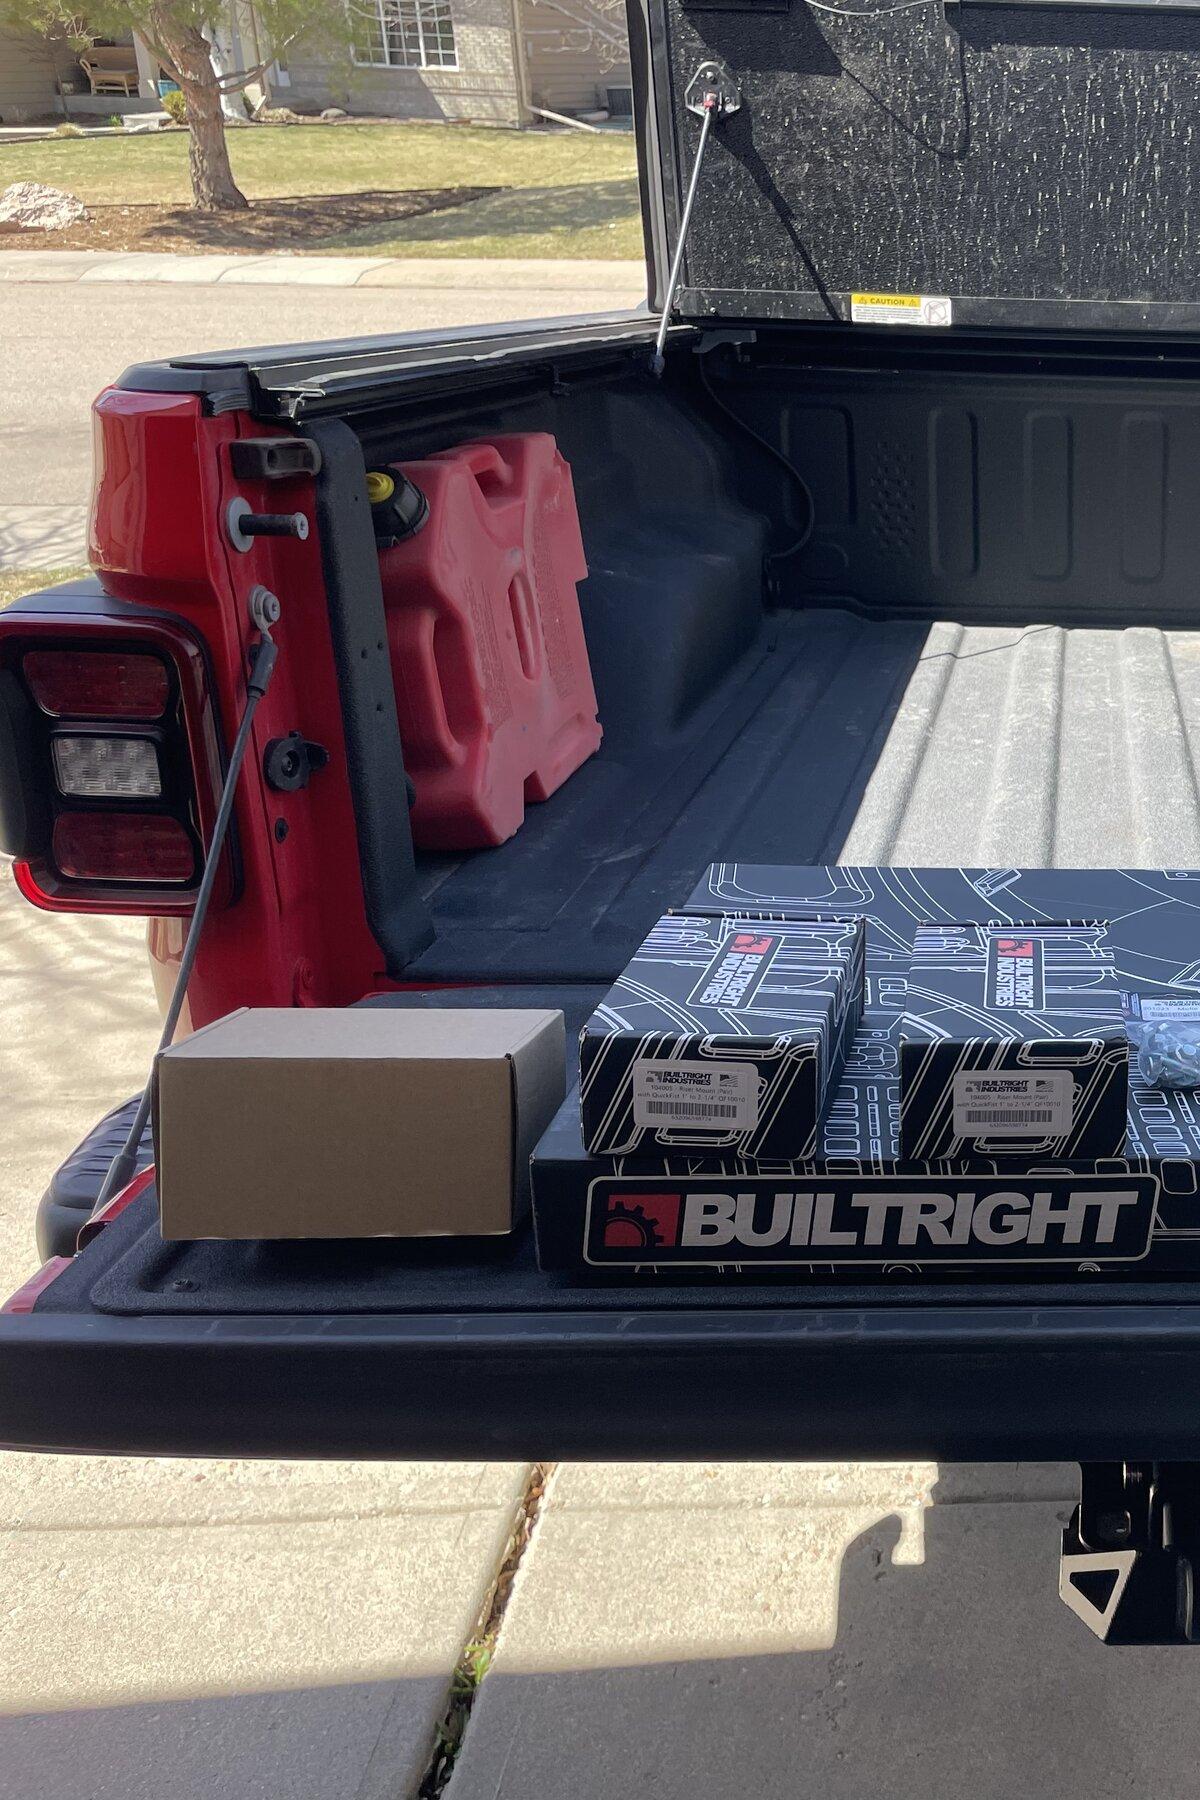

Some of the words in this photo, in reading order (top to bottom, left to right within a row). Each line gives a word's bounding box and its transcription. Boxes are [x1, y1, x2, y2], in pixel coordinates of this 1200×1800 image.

[870, 298, 905, 306] CAUTION
[700, 953, 745, 1004] INDUSTRIES
[720, 955, 764, 1007] BUILTRIGHT
[995, 956, 1015, 1007] INDUSTRIES
[1015, 957, 1034, 1008] BUILTRIGHT
[662, 1078, 711, 1086] INDUSTRIES
[663, 1071, 712, 1081] BUILTRIGHT
[680, 1190, 1139, 1248] BUILTRIGHT
